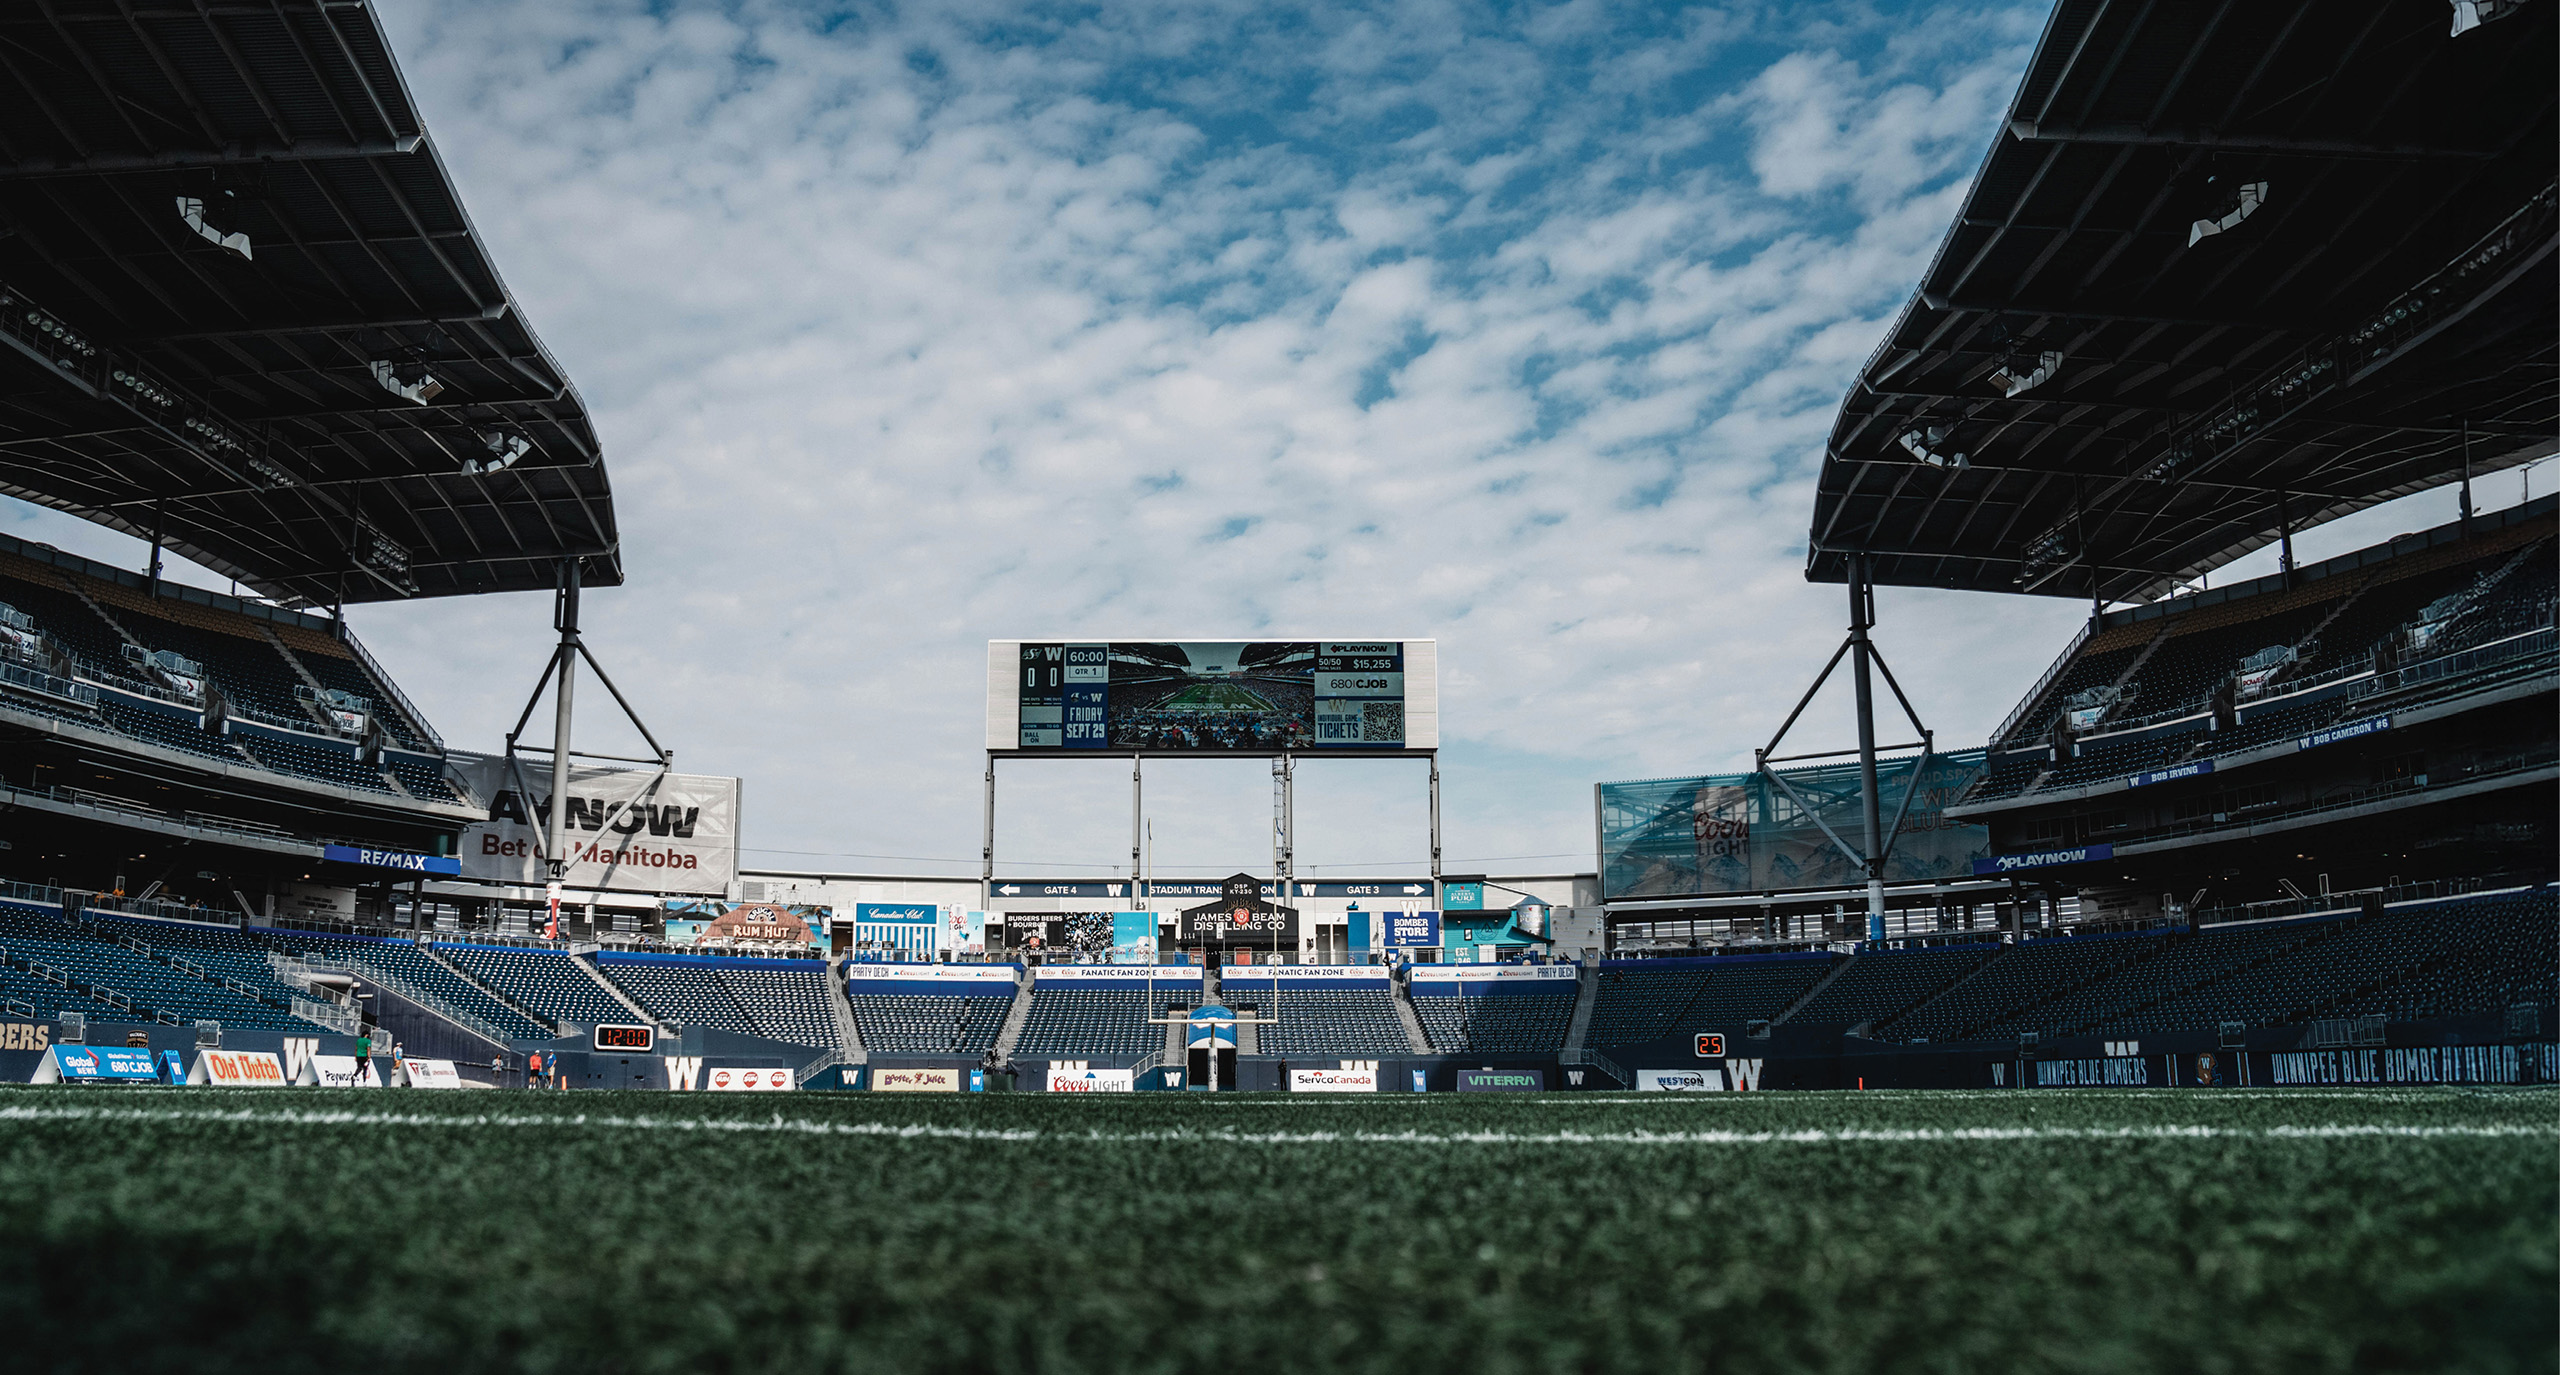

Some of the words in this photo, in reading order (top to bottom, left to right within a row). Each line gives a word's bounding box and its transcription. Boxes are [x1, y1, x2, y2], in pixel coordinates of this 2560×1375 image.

[1044, 647, 1062, 661] W
[1070, 652, 1104, 662] 60:00
[1318, 658, 1342, 666] 50/50
[1353, 659, 1392, 670] $15,255
[1028, 667, 1035, 688] 0
[1050, 667, 1058, 688] 0
[1090, 693, 1102, 702] W
[1070, 707, 1102, 722] FRIDAY
[1066, 723, 1090, 738] SEPT
[1092, 723, 1105, 738] 29
[1317, 722, 1359, 738] TICKETS
[2314, 734, 2330, 744] BOB
[2332, 722, 2372, 740] CAMERON
[2376, 718, 2388, 729] #6
[2129, 777, 2140, 787] W
[2151, 772, 2168, 783] BOB
[2169, 766, 2198, 779] IRVING
[482, 834, 527, 858] Bet
[574, 841, 698, 870] Manitoba
[1698, 840, 1748, 856] LIGHT
[360, 850, 426, 870] RE/MAX
[2006, 850, 2086, 869] PLAYNOW
[551, 861, 561, 878] 4
[1868, 862, 1878, 878] 3
[1044, 886, 1068, 894] GATE
[1070, 886, 1077, 894] 4
[1107, 884, 1123, 897] W
[1150, 886, 1192, 894] STADIUM
[1300, 884, 1317, 896] W
[1346, 886, 1372, 894] GATE
[1373, 886, 1380, 894] 3
[748, 906, 775, 920] BRUGAL
[869, 908, 905, 919] Canadian
[905, 908, 925, 920] Club
[1400, 900, 1422, 918] W
[1194, 913, 1232, 922] JAMES
[1252, 913, 1286, 922] BEAM
[733, 925, 760, 938] RUM
[764, 926, 790, 938] HUT
[1267, 922, 1286, 930] CO
[1394, 927, 1428, 937] STORE
[1455, 948, 1469, 957] EST.
[853, 966, 872, 977] PARTY
[873, 967, 889, 978] DECK
[1538, 967, 1556, 978] PARTY
[1558, 967, 1574, 977] DECK
[607, 1029, 646, 1046] 12:00
[1700, 1037, 1721, 1054] 25
[66, 1056, 94, 1067] Global
[111, 1061, 129, 1072] 680
[129, 1062, 154, 1073] CJOB
[210, 1054, 240, 1080] Old
[238, 1055, 280, 1080] Dutch
[2271, 1051, 2338, 1084] WINNIPEG
[2342, 1049, 2380, 1083] BLUE
[76, 1067, 98, 1075] NEWS
[325, 1070, 360, 1086] Paywors
[842, 1070, 859, 1084] W
[1568, 1071, 1584, 1085] W
[2036, 1060, 2076, 1086] WINNIPEG
[2078, 1059, 2101, 1085] BLUE
[2103, 1058, 2148, 1085] BOMBERS
[884, 1074, 913, 1085] Booster
[923, 1074, 946, 1085] Juice
[1054, 1076, 1090, 1091] Coors
[1092, 1081, 1126, 1091] LIGHT
[1164, 1072, 1182, 1087] W
[1298, 1074, 1371, 1085] ServcoCanada
[1468, 1076, 1536, 1086] VITERRA
[1657, 1077, 1704, 1086] WESTCON
